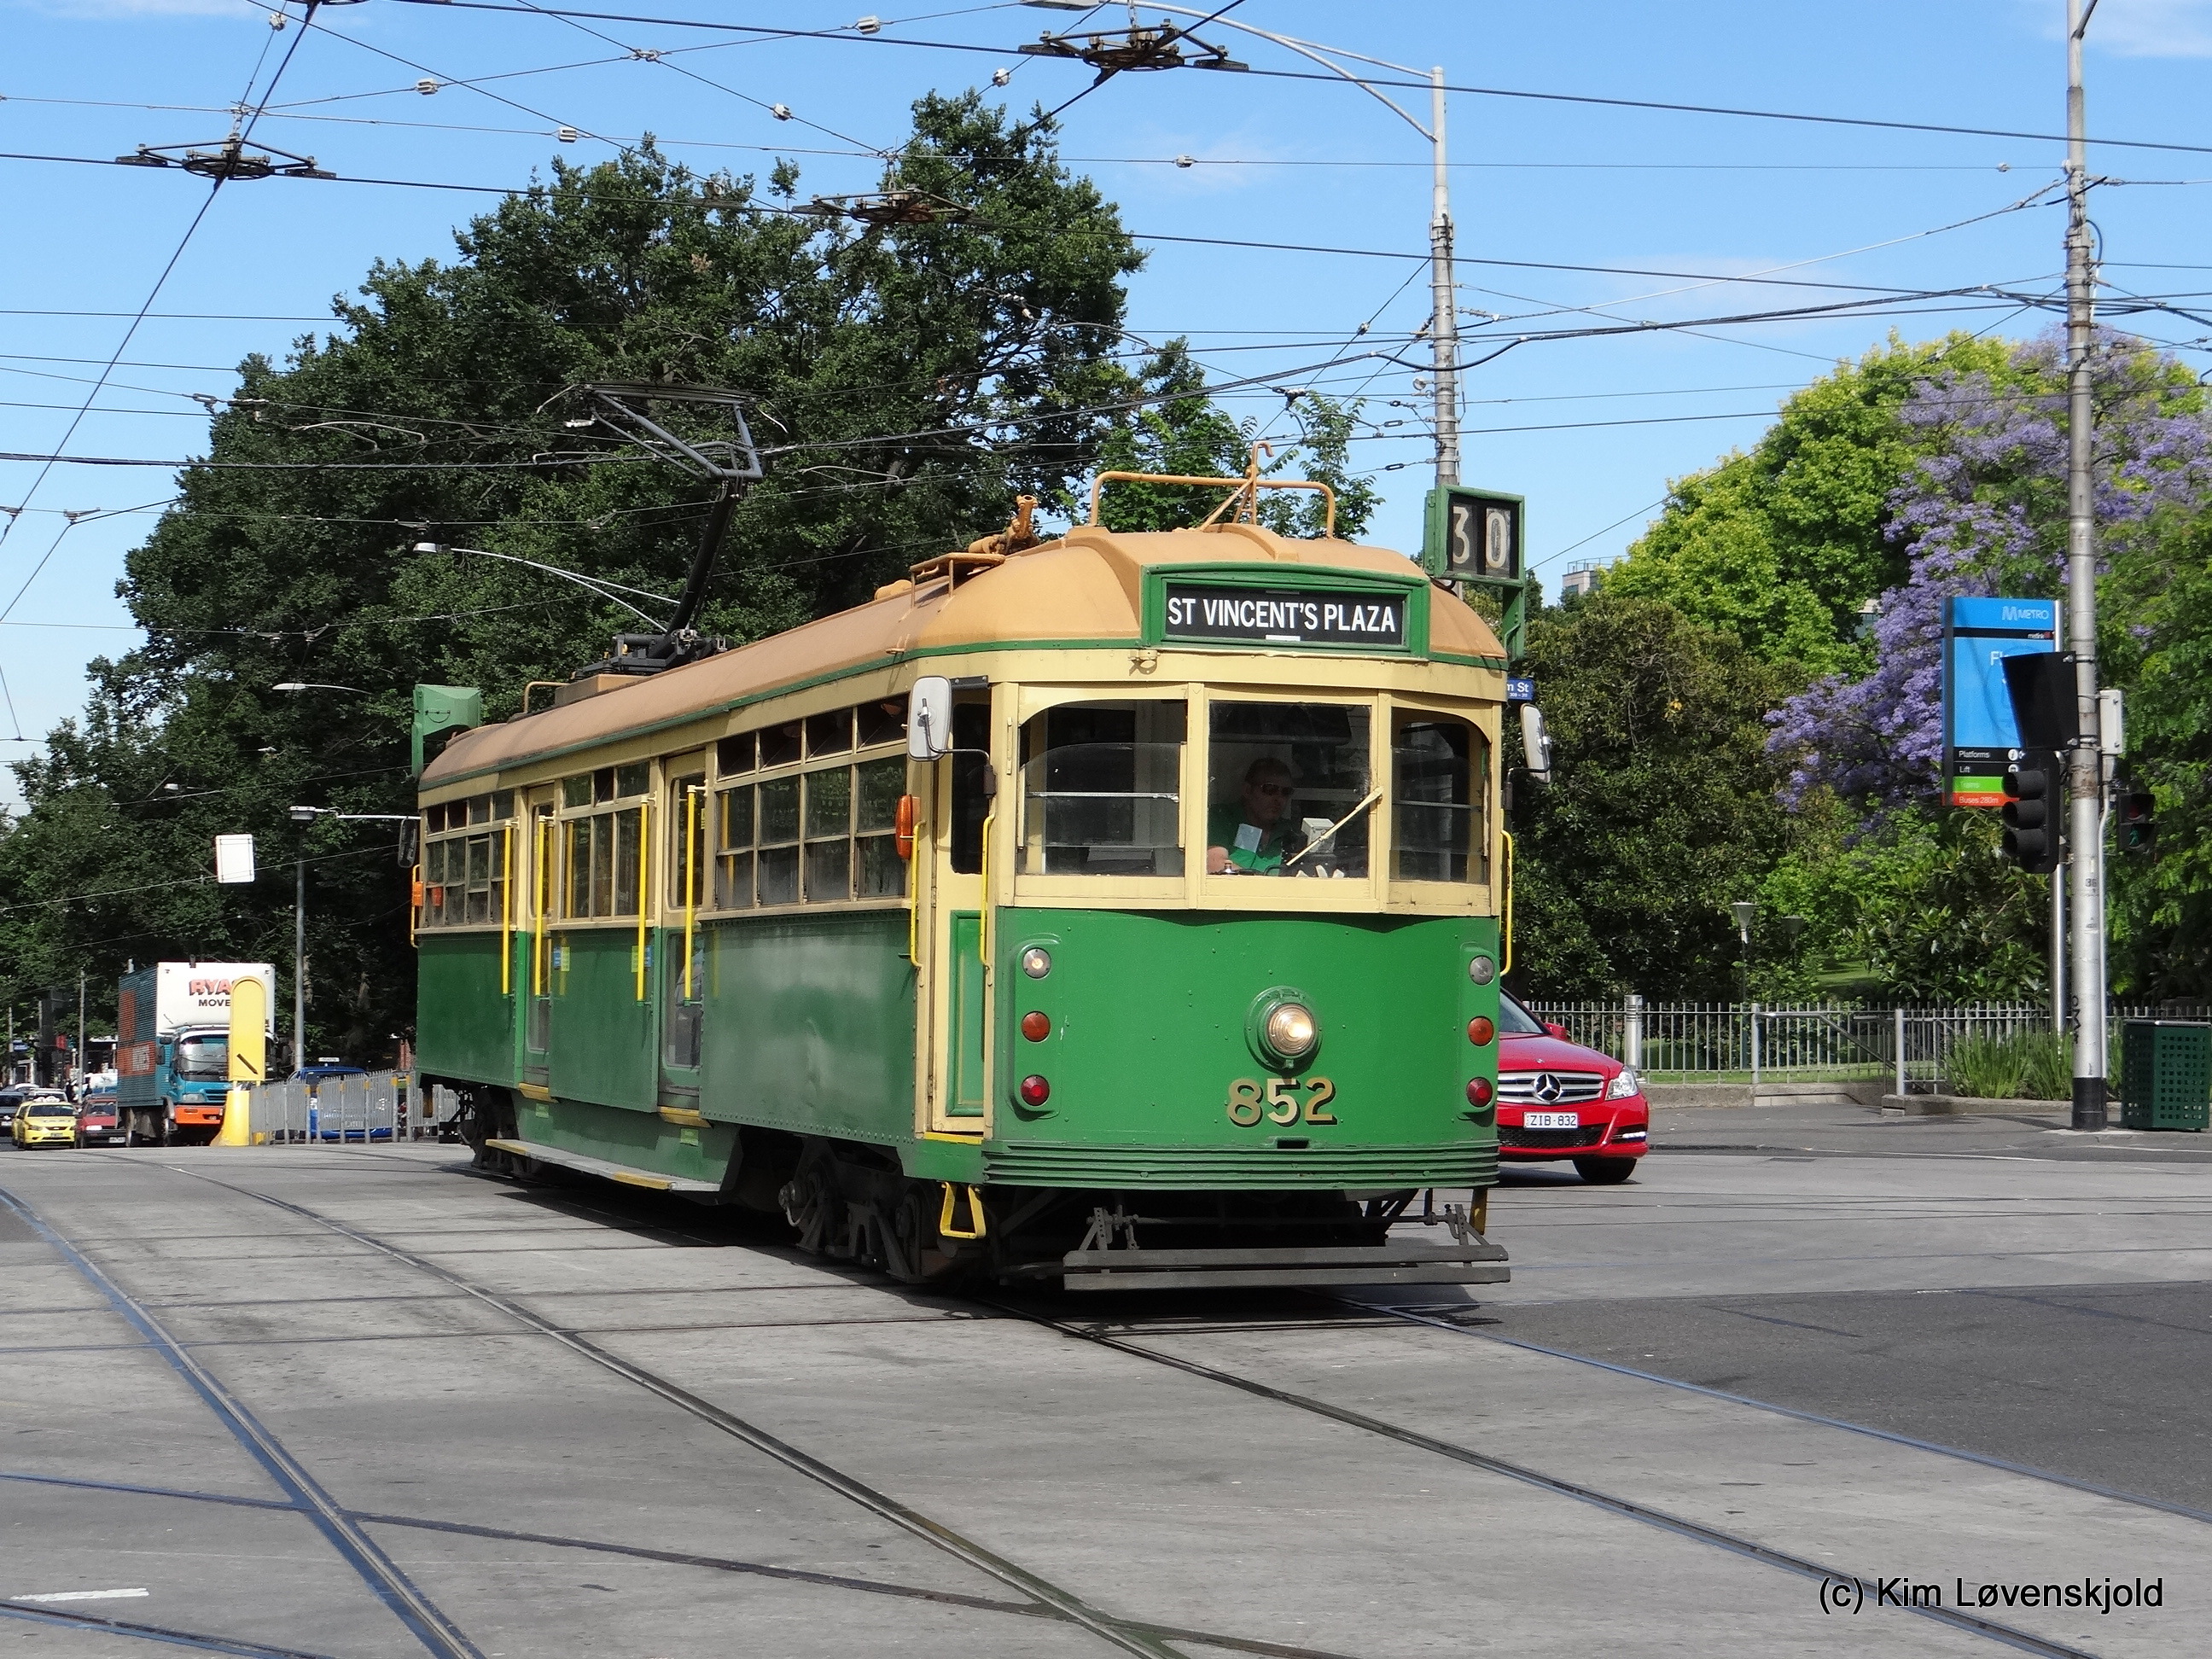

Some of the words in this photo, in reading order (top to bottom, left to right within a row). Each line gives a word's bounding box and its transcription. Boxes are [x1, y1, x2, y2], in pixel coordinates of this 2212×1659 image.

[1452, 506, 1507, 568] 30
[1167, 597, 1196, 625] ST
[1203, 599, 1318, 630] VINCENT'S
[1324, 603, 1396, 632] PLAZA
[2018, 609, 2049, 620] METRO
[1517, 682, 1529, 692] St
[1959, 750, 1990, 759] Platforms
[189, 979, 237, 996] RYA
[1227, 1077, 1337, 1127] 852
